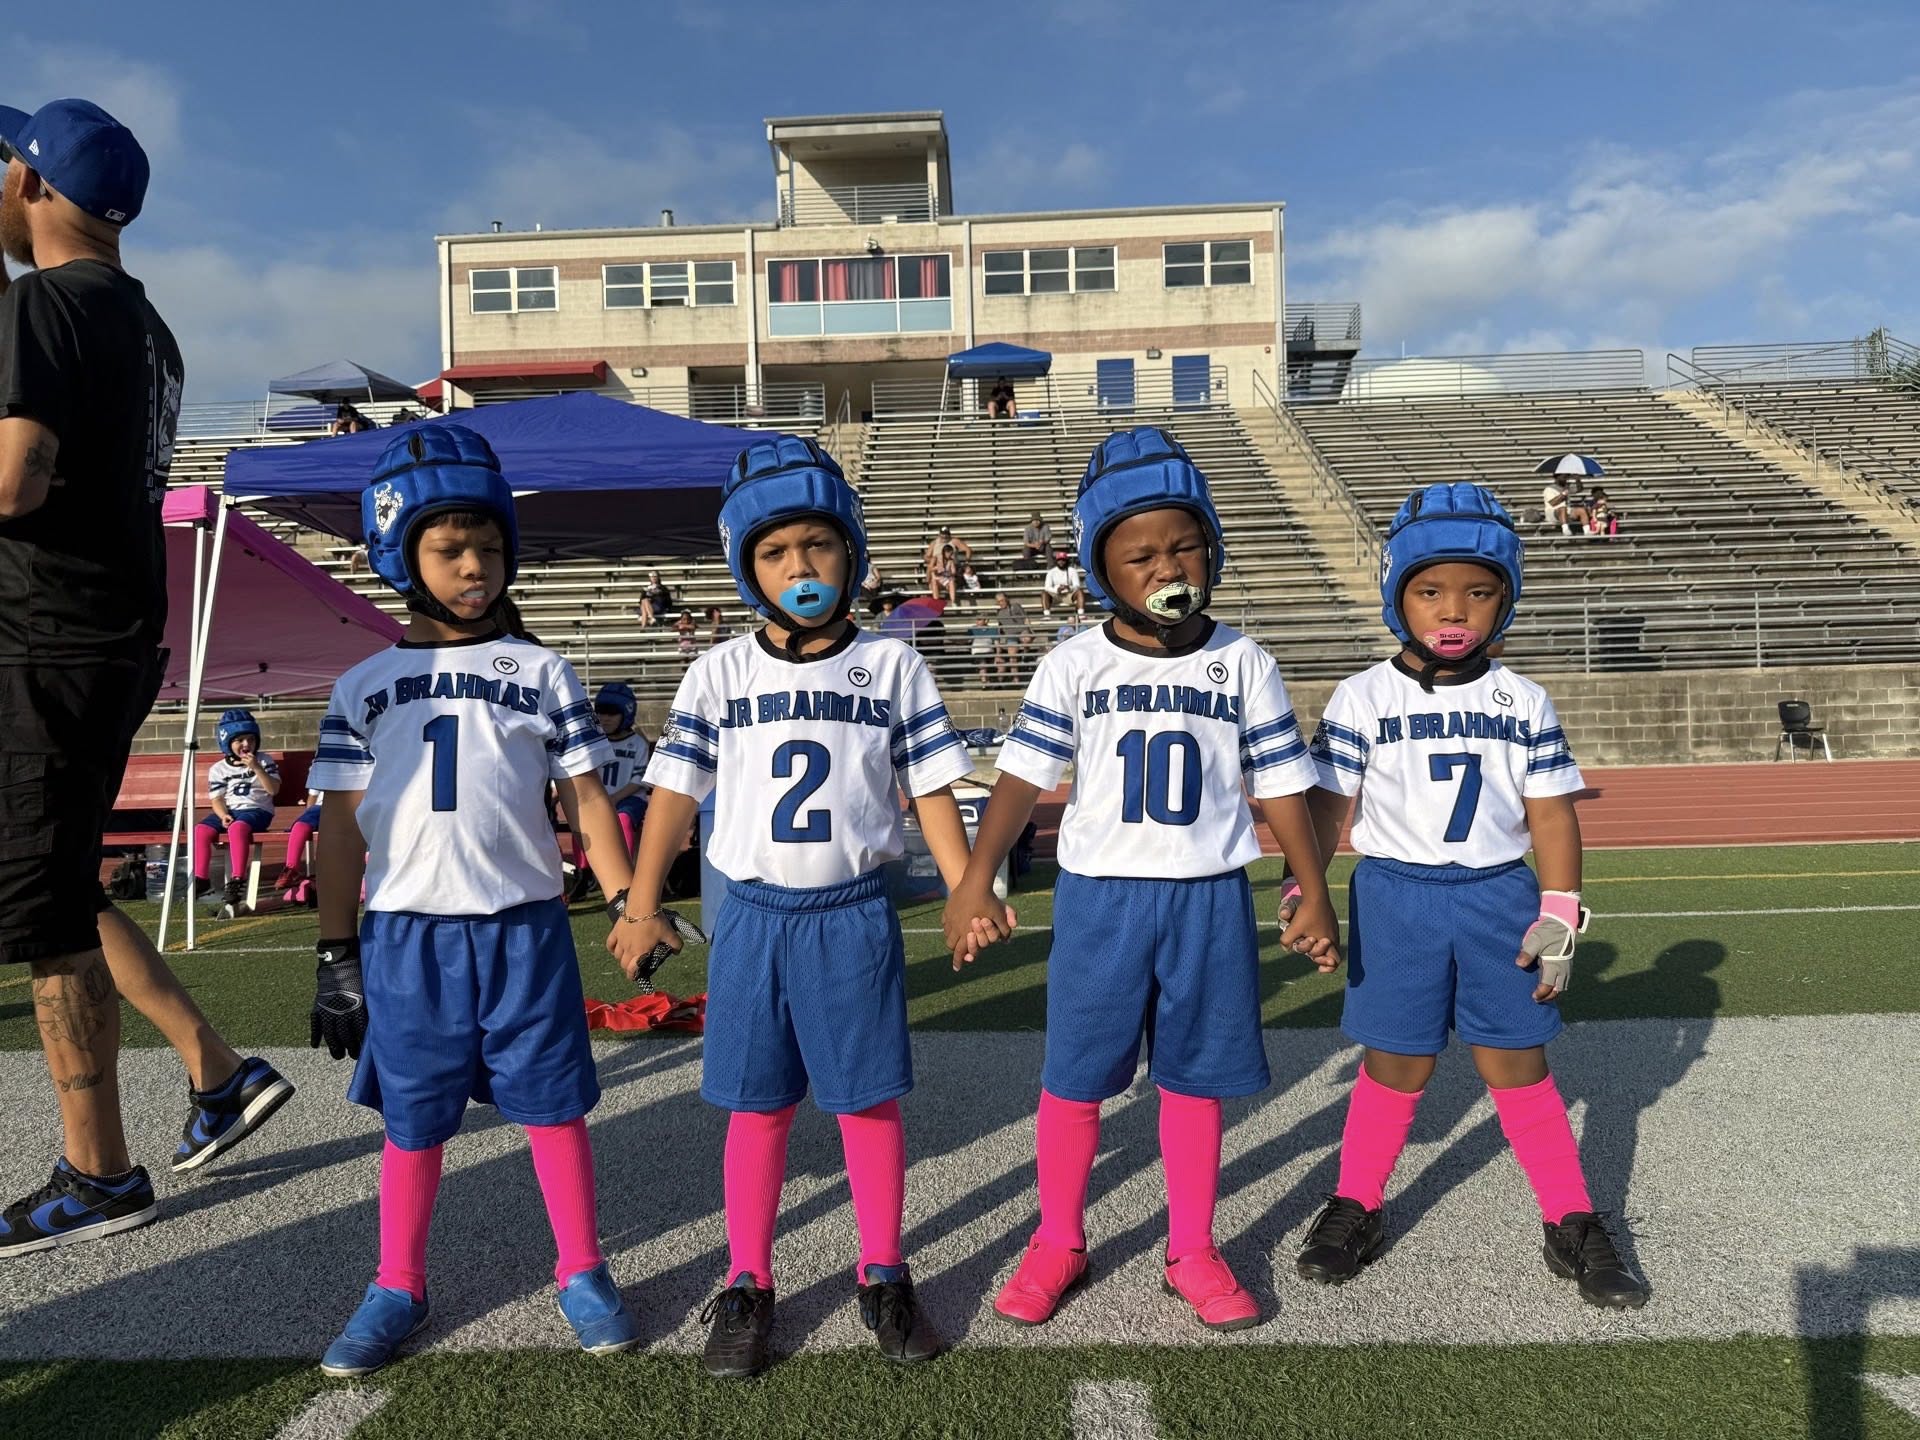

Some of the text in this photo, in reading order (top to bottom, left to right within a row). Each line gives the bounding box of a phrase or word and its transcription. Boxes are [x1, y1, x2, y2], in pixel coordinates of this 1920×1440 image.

[395, 672, 541, 716] BRAHMAS
[719, 690, 891, 729] JR BRAHMAS
[1083, 689, 1110, 719] JR
[1375, 711, 1530, 747] JR BRAHMAS
[422, 714, 459, 812] 1
[771, 739, 832, 844] 2
[1116, 729, 1203, 826] 10
[1428, 752, 1482, 843] 7
